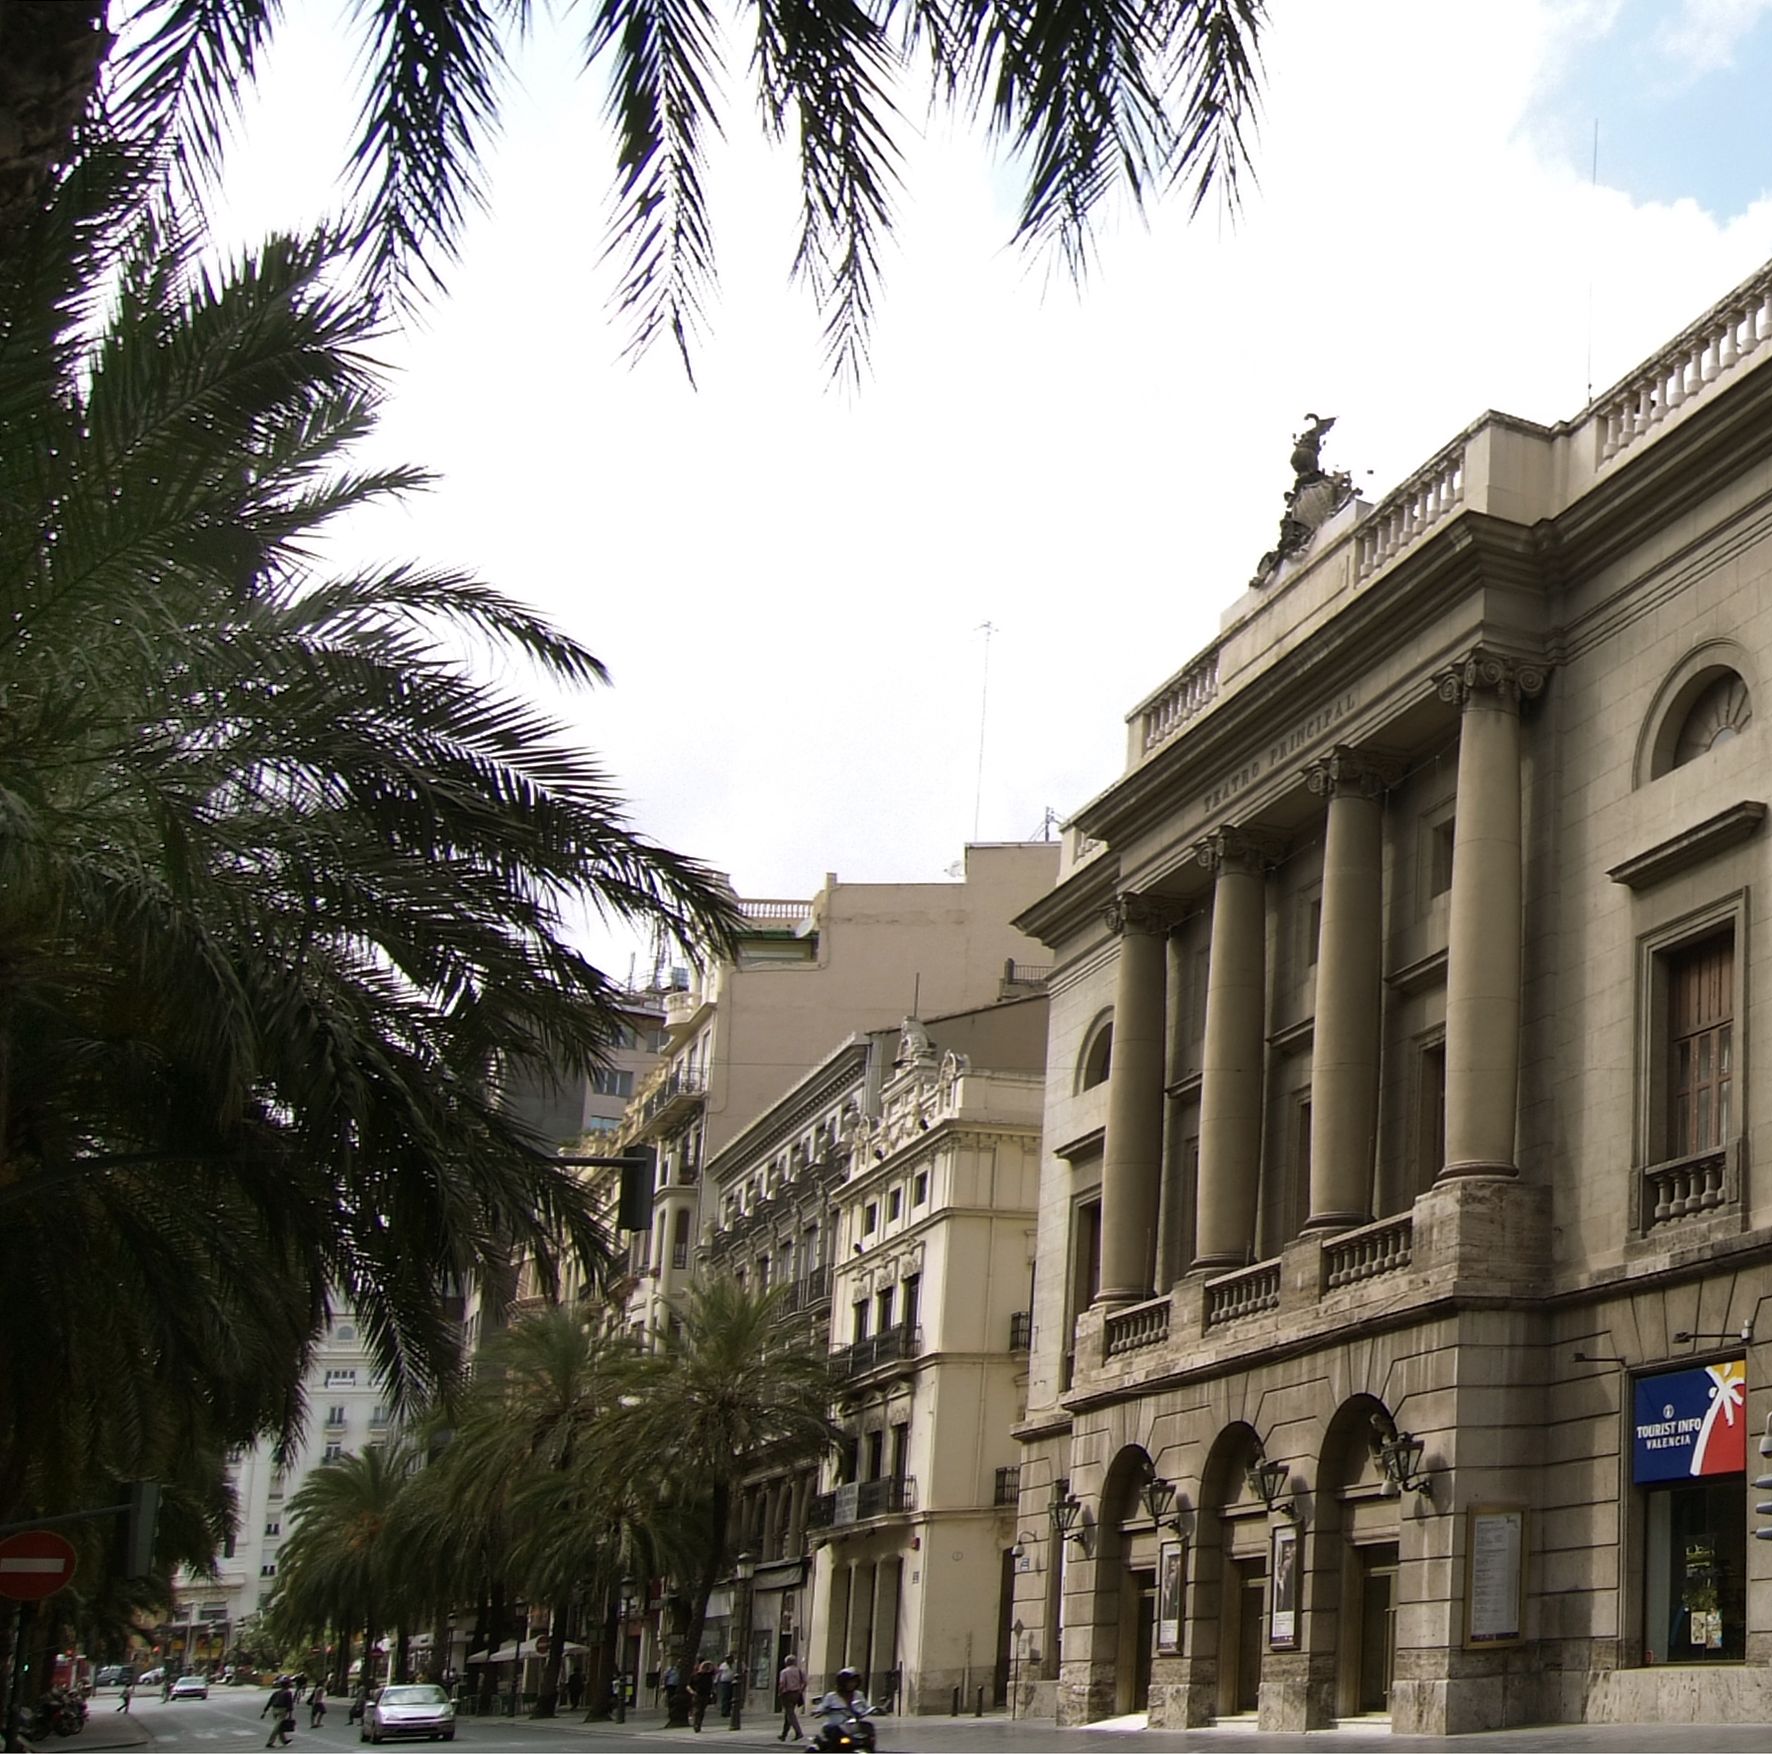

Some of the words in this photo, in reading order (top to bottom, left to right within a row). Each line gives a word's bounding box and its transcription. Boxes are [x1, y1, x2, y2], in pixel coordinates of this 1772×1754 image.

[1204, 761, 1260, 814] TEATRO
[1270, 694, 1356, 767] PRINCIPAL
[1637, 1421, 1676, 1438] TOURIST
[1678, 1417, 1702, 1433] INFO
[1646, 1434, 1691, 1449] VALENCIA
